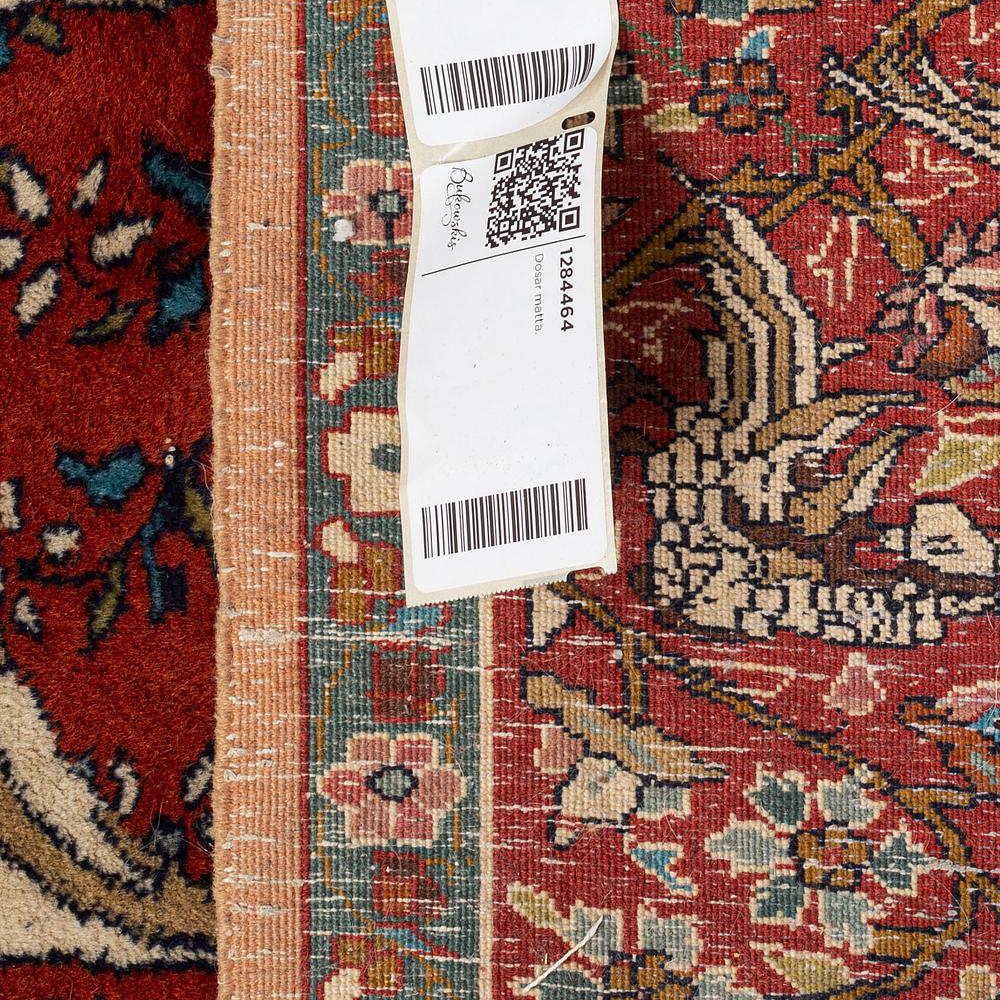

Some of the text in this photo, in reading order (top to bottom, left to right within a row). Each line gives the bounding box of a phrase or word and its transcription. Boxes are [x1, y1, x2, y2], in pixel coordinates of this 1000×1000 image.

[441, 167, 474, 252] Bukowskis
[534, 253, 545, 335] Dosar matta.
[559, 246, 575, 332] 1284464
